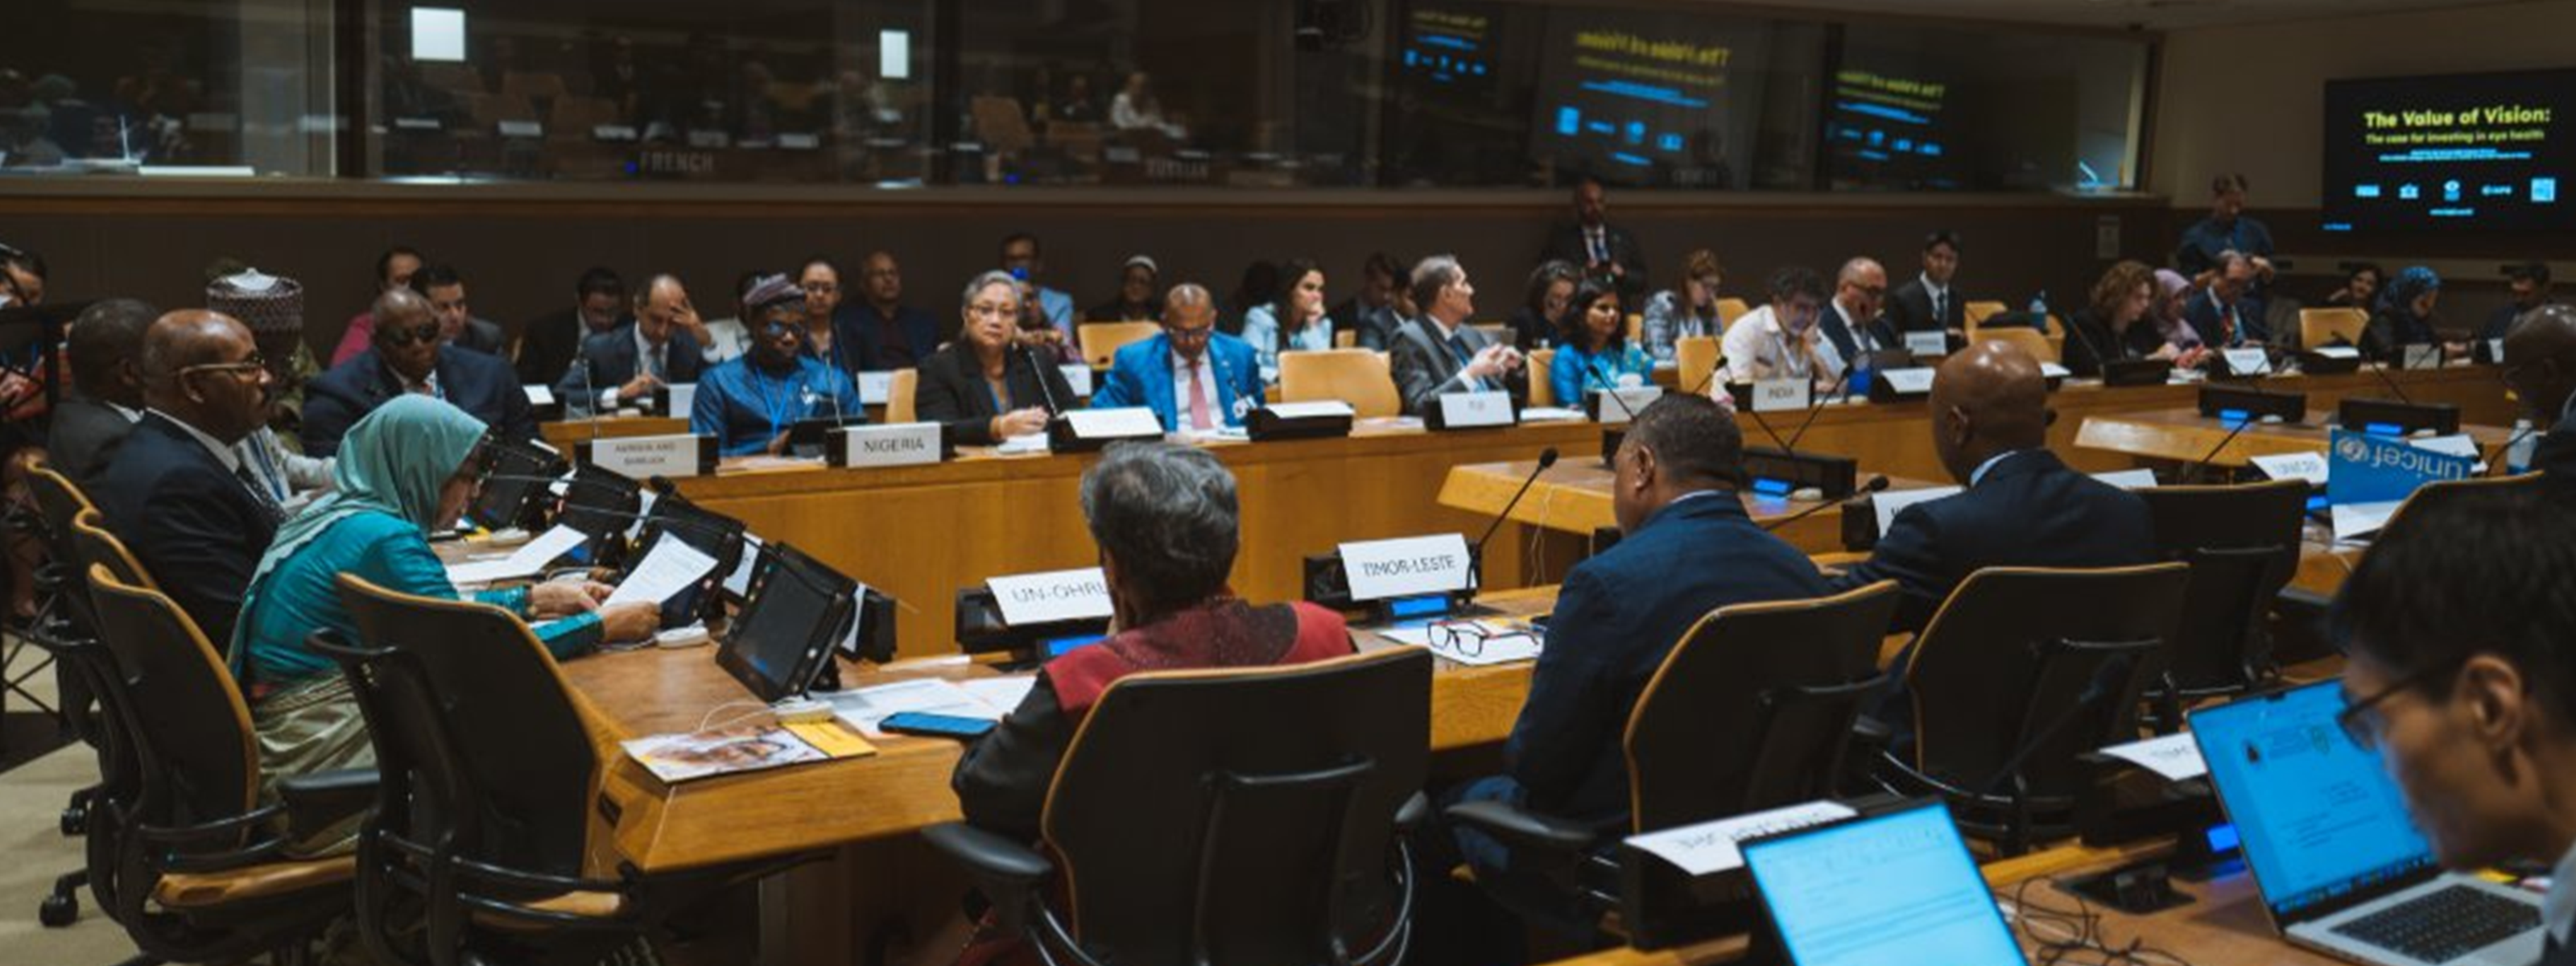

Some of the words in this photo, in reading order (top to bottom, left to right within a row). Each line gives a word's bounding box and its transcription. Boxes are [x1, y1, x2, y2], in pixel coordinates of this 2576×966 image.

[2364, 112, 2397, 128] The
[2403, 109, 2454, 126] Value
[2458, 107, 2479, 125] of
[2484, 105, 2551, 124] Vision:
[2366, 134, 2384, 144] The
[2386, 134, 2409, 144] case
[2410, 133, 2425, 143] for
[2427, 131, 2474, 144] investing
[2475, 130, 2486, 141] in
[2488, 131, 2508, 142] eye
[2510, 129, 2545, 140] health
[640, 151, 714, 173] FRENCH
[864, 437, 925, 453] NIGERIA
[2371, 444, 2463, 481] unicef
[1363, 554, 1455, 576] TIMOR-LESTE
